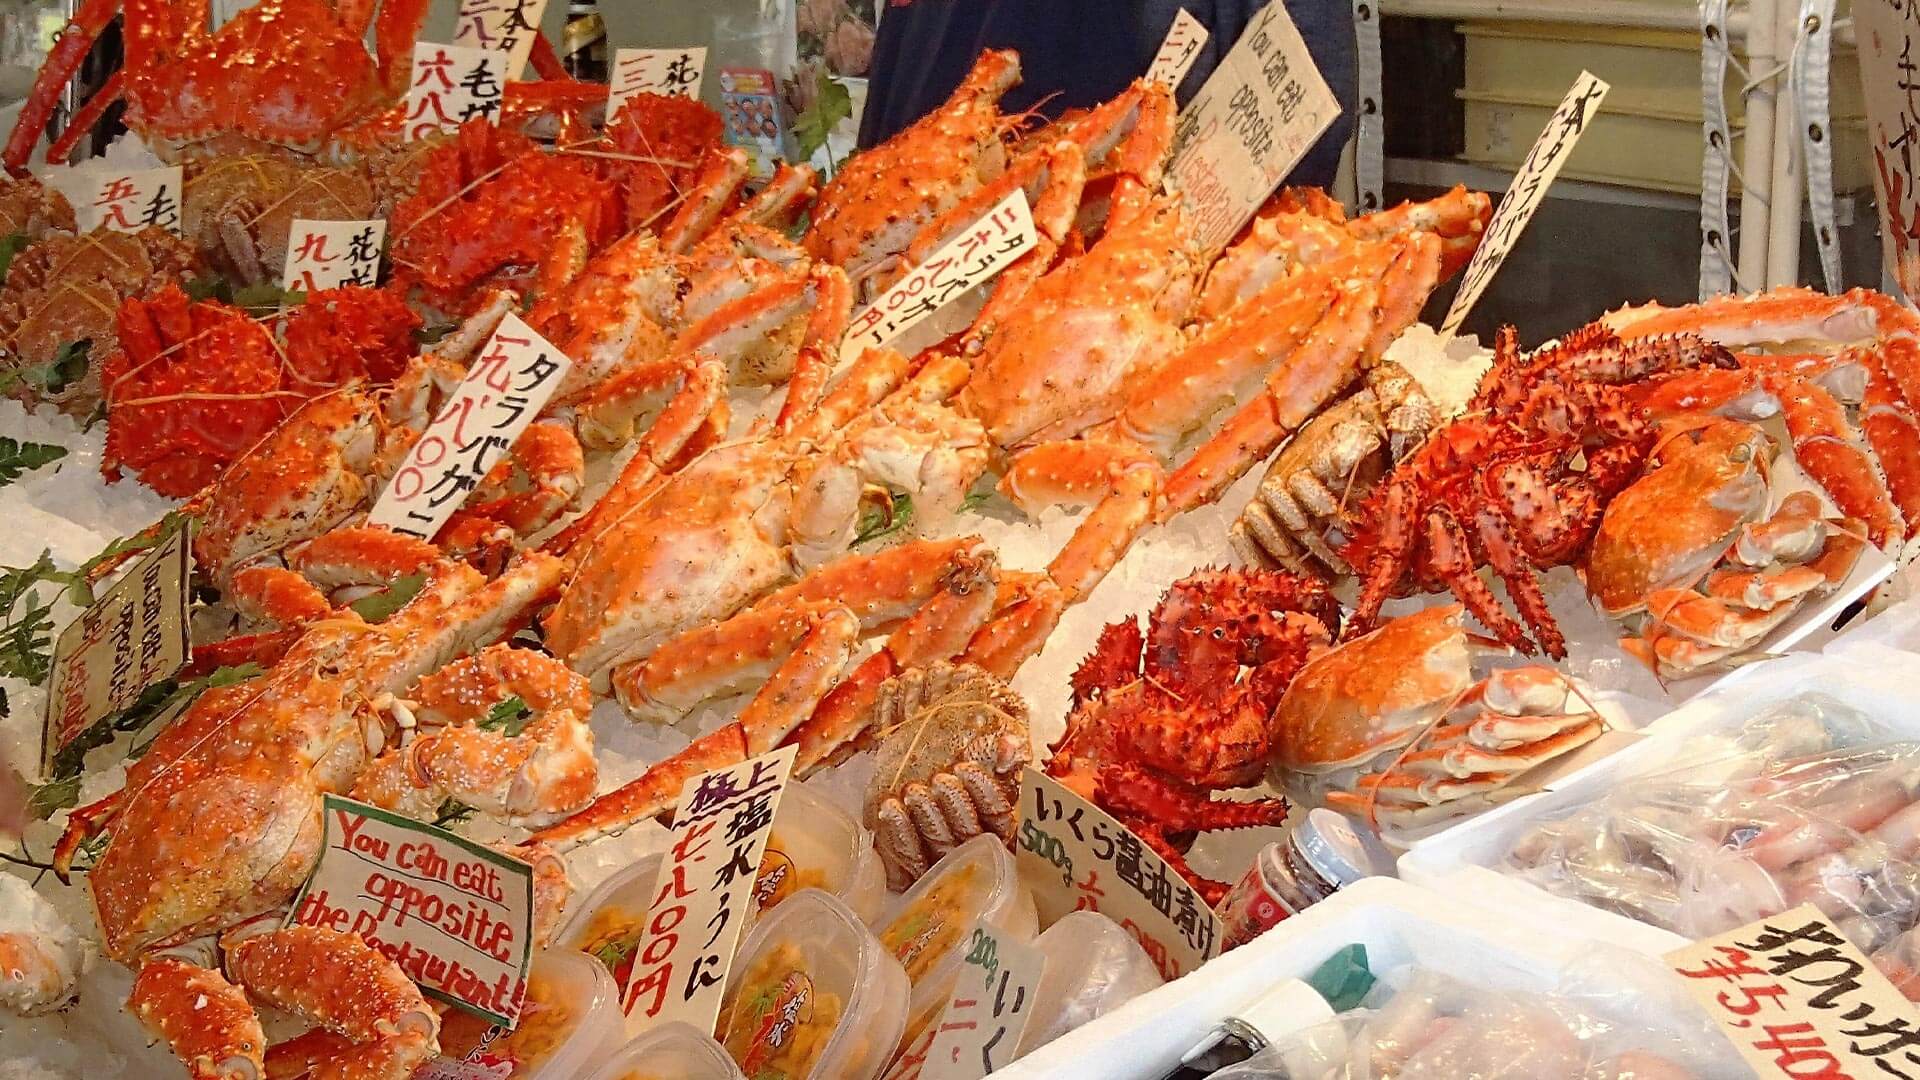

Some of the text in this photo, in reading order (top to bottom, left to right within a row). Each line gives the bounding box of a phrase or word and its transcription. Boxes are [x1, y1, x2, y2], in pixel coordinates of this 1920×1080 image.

[657, 54, 700, 95] 花
[1262, 50, 1289, 93] can
[1276, 79, 1307, 124] eat
[1225, 84, 1274, 165] opposite
[141, 184, 180, 234] 毛
[872, 233, 1025, 344] タラバガニ
[392, 354, 559, 539] タラバガニ
[336, 808, 503, 902] You can eat
[1018, 818, 1073, 888] 500g
[295, 890, 350, 927] the
[364, 872, 514, 963] opposite
[685, 795, 773, 1002] 塩水うに
[1675, 946, 1856, 1080] ¥5,40
